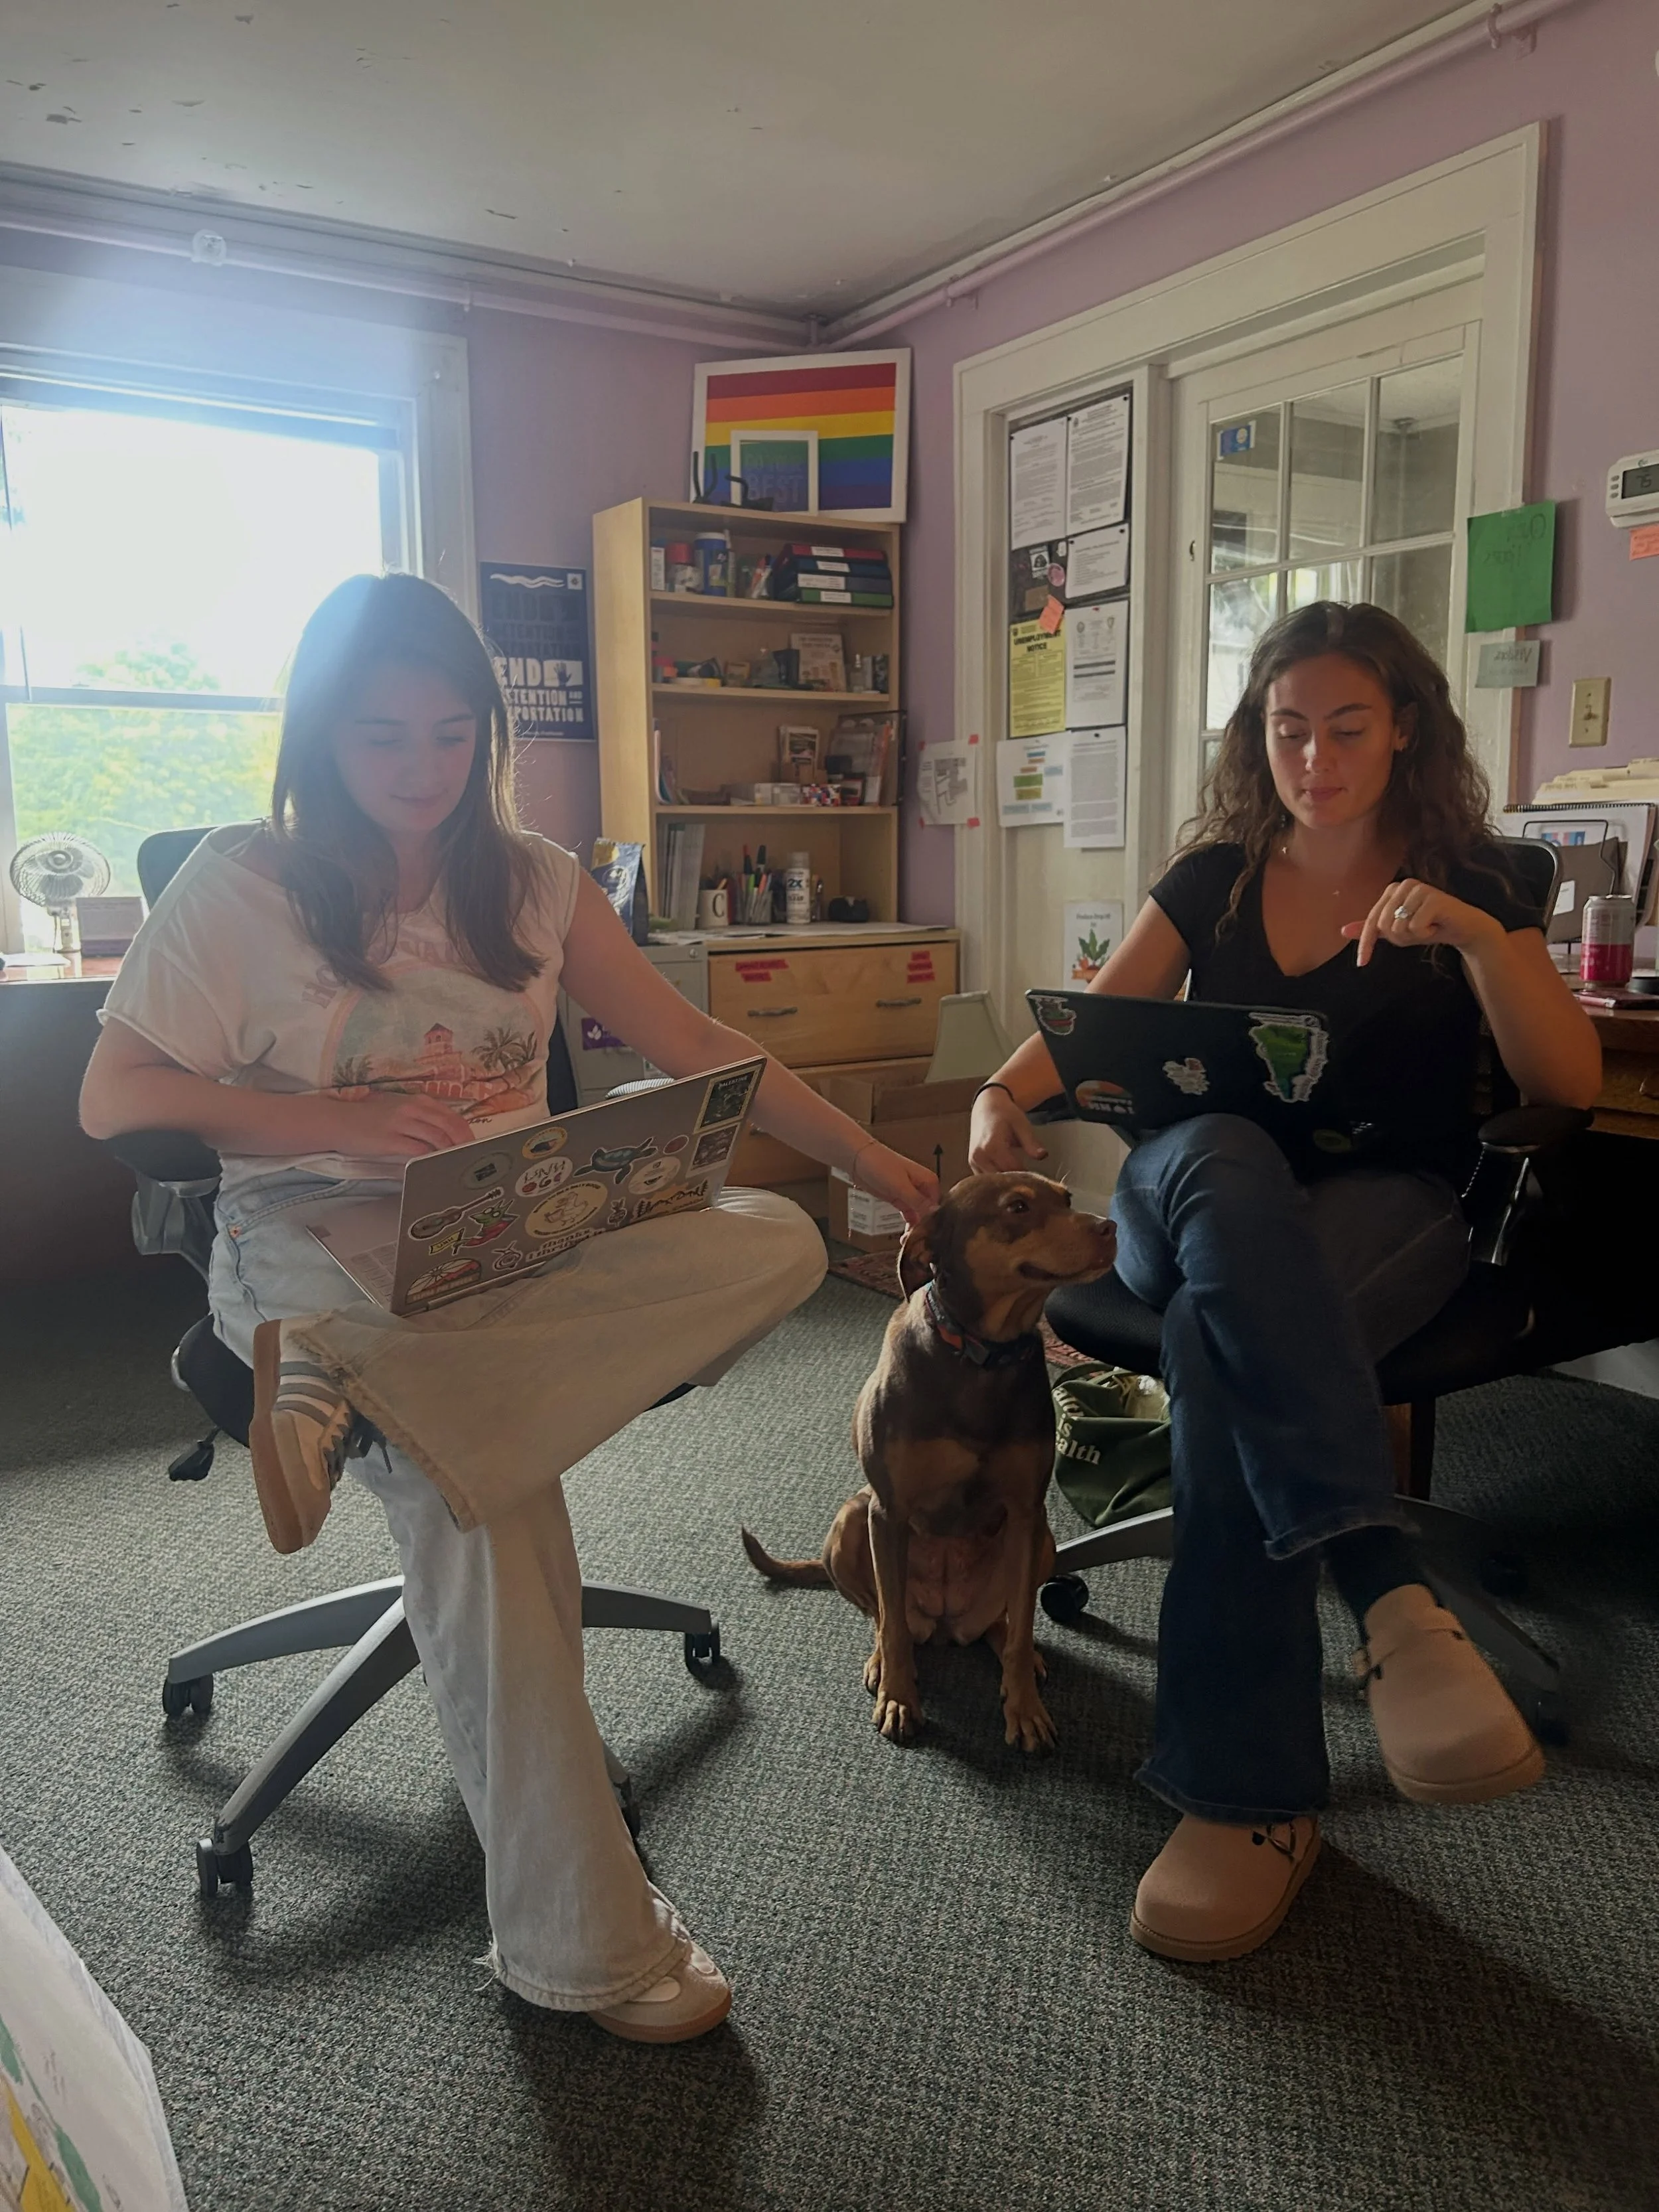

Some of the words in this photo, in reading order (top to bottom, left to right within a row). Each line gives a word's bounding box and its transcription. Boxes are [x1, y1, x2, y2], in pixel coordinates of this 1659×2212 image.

[747, 473, 804, 503] BEST
[1026, 642, 1048, 652] NOTICE
[513, 705, 584, 722] PORTATION
[1057, 1412, 1073, 1438] is
